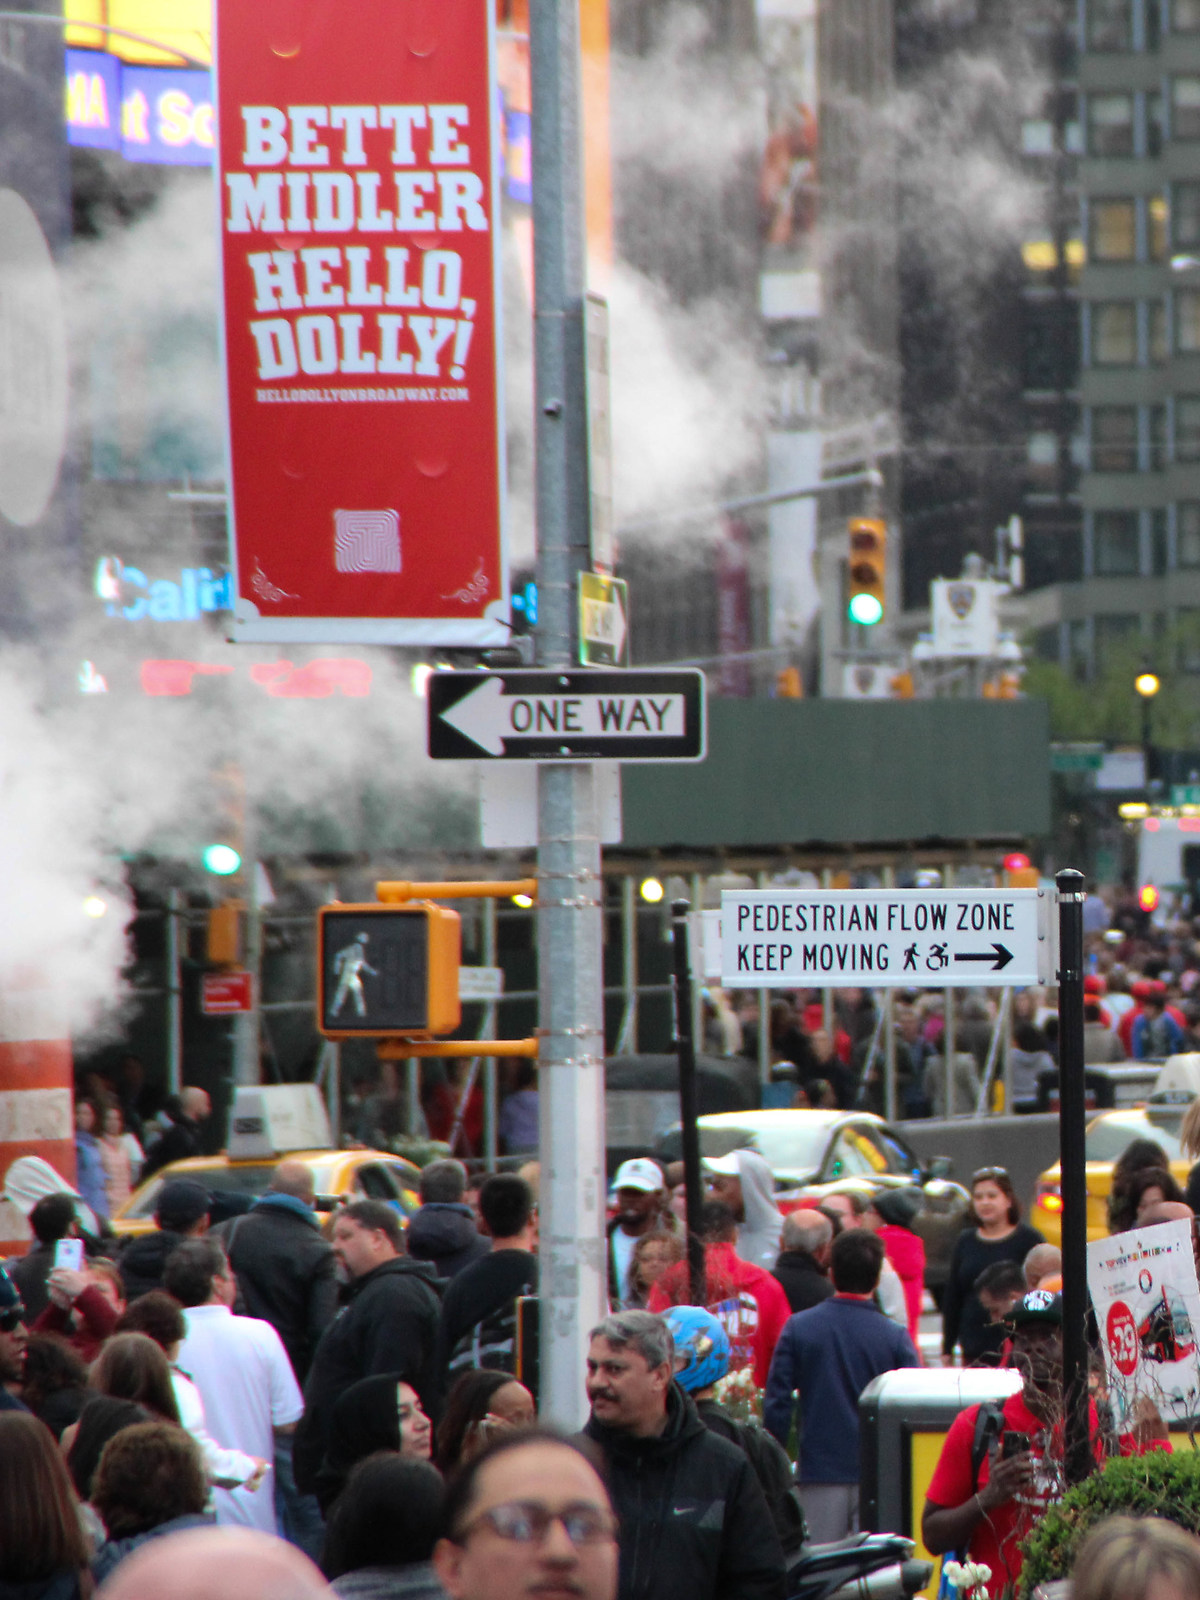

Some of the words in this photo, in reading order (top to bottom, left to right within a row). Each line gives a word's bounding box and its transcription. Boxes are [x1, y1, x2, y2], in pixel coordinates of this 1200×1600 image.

[241, 105, 470, 166] BETTE
[225, 172, 489, 232] MIDLER
[247, 247, 477, 319] HELLO,
[250, 314, 474, 381] DOLLY!
[510, 699, 583, 732] ONE
[599, 698, 673, 732] WAY
[737, 904, 878, 932] PEDESTRIAN
[887, 903, 948, 931] FLOW
[956, 903, 1015, 931] ZONE
[737, 944, 793, 972] KEEP
[802, 943, 889, 972] MOVING
[1110, 1323, 1136, 1362] $29
